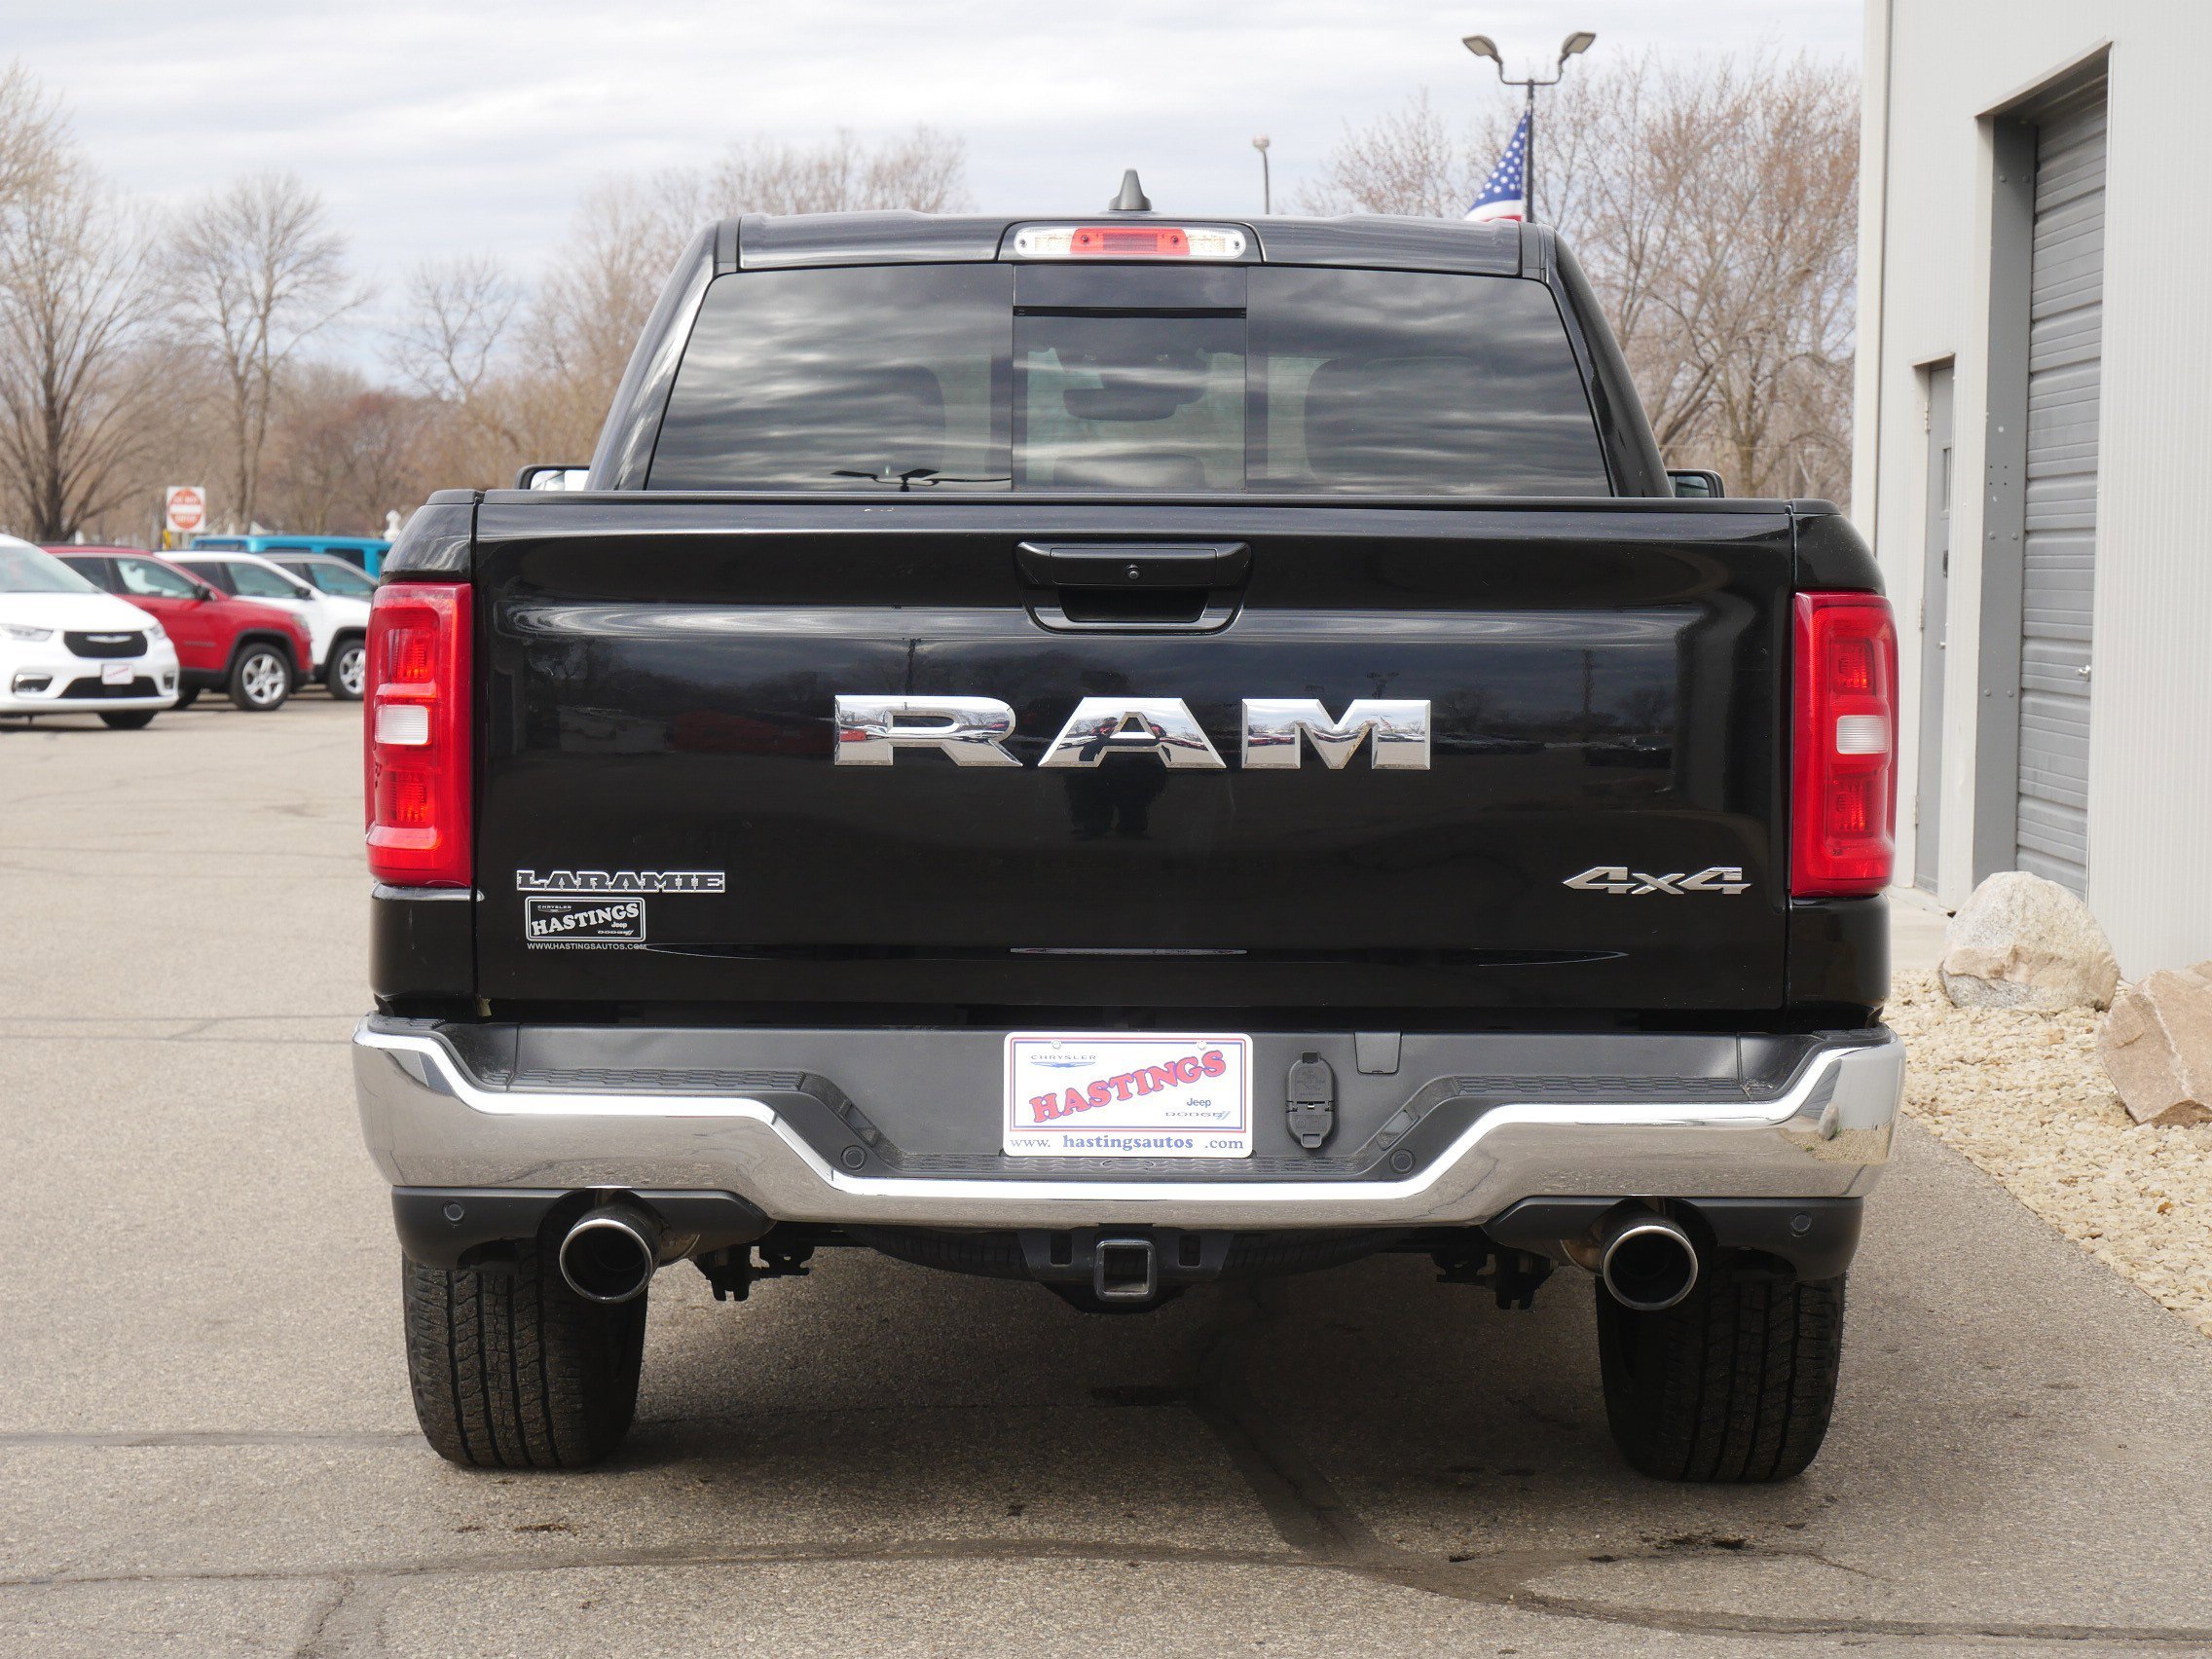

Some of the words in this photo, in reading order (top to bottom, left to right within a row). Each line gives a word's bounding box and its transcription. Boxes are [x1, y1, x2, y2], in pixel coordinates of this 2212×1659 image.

[834, 694, 1431, 770] RAM
[516, 869, 725, 893] LARAMIE
[532, 903, 640, 936] HASTINGS
[1029, 1050, 1226, 1123] HASTINGS
[1186, 1097, 1211, 1108] Jeep
[1062, 1134, 1194, 1151] hastingsautos
